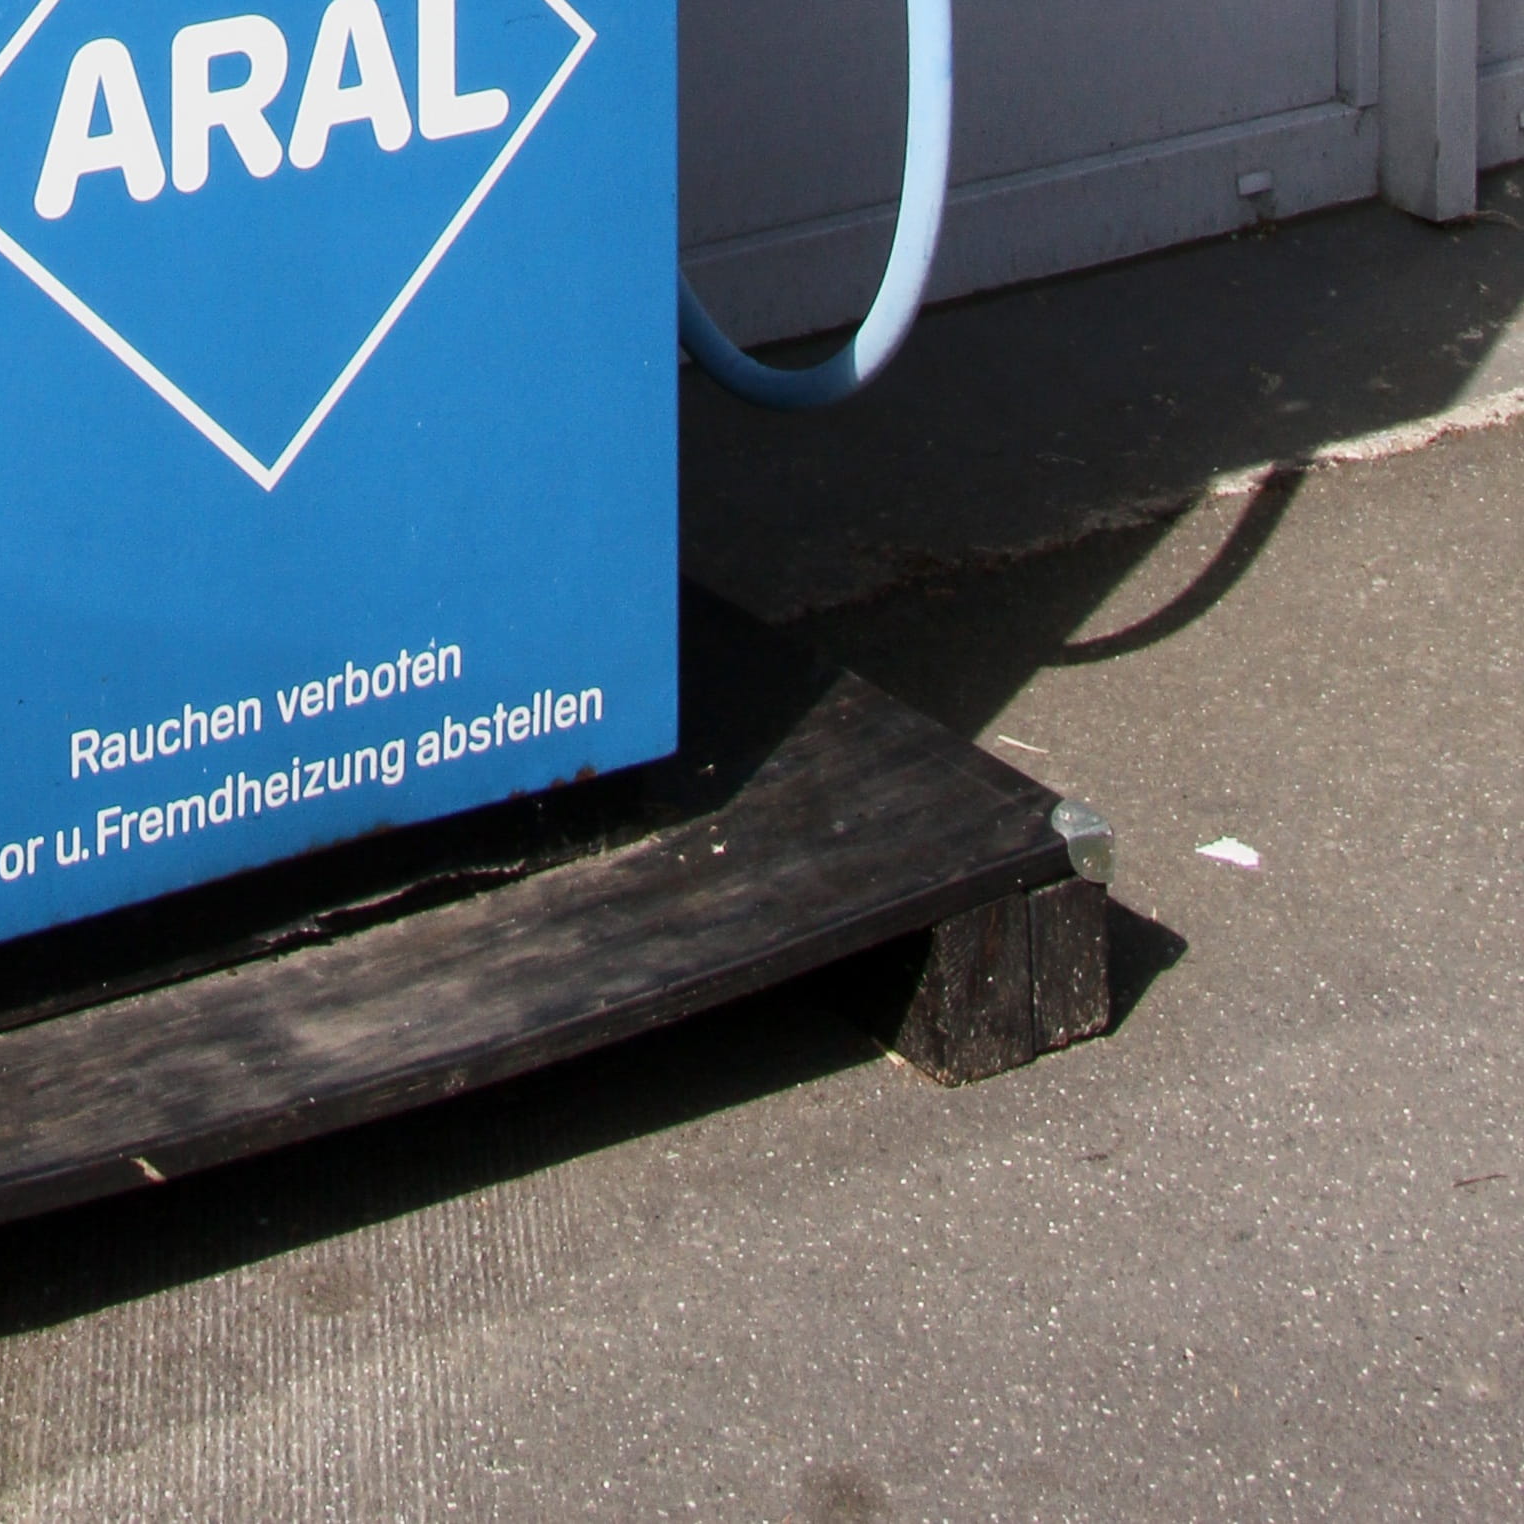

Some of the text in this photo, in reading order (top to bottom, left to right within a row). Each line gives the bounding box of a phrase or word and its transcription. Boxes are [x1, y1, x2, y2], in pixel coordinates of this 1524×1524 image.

[69, 642, 462, 779] Rauchen verboten
[415, 686, 603, 768] abstellen
